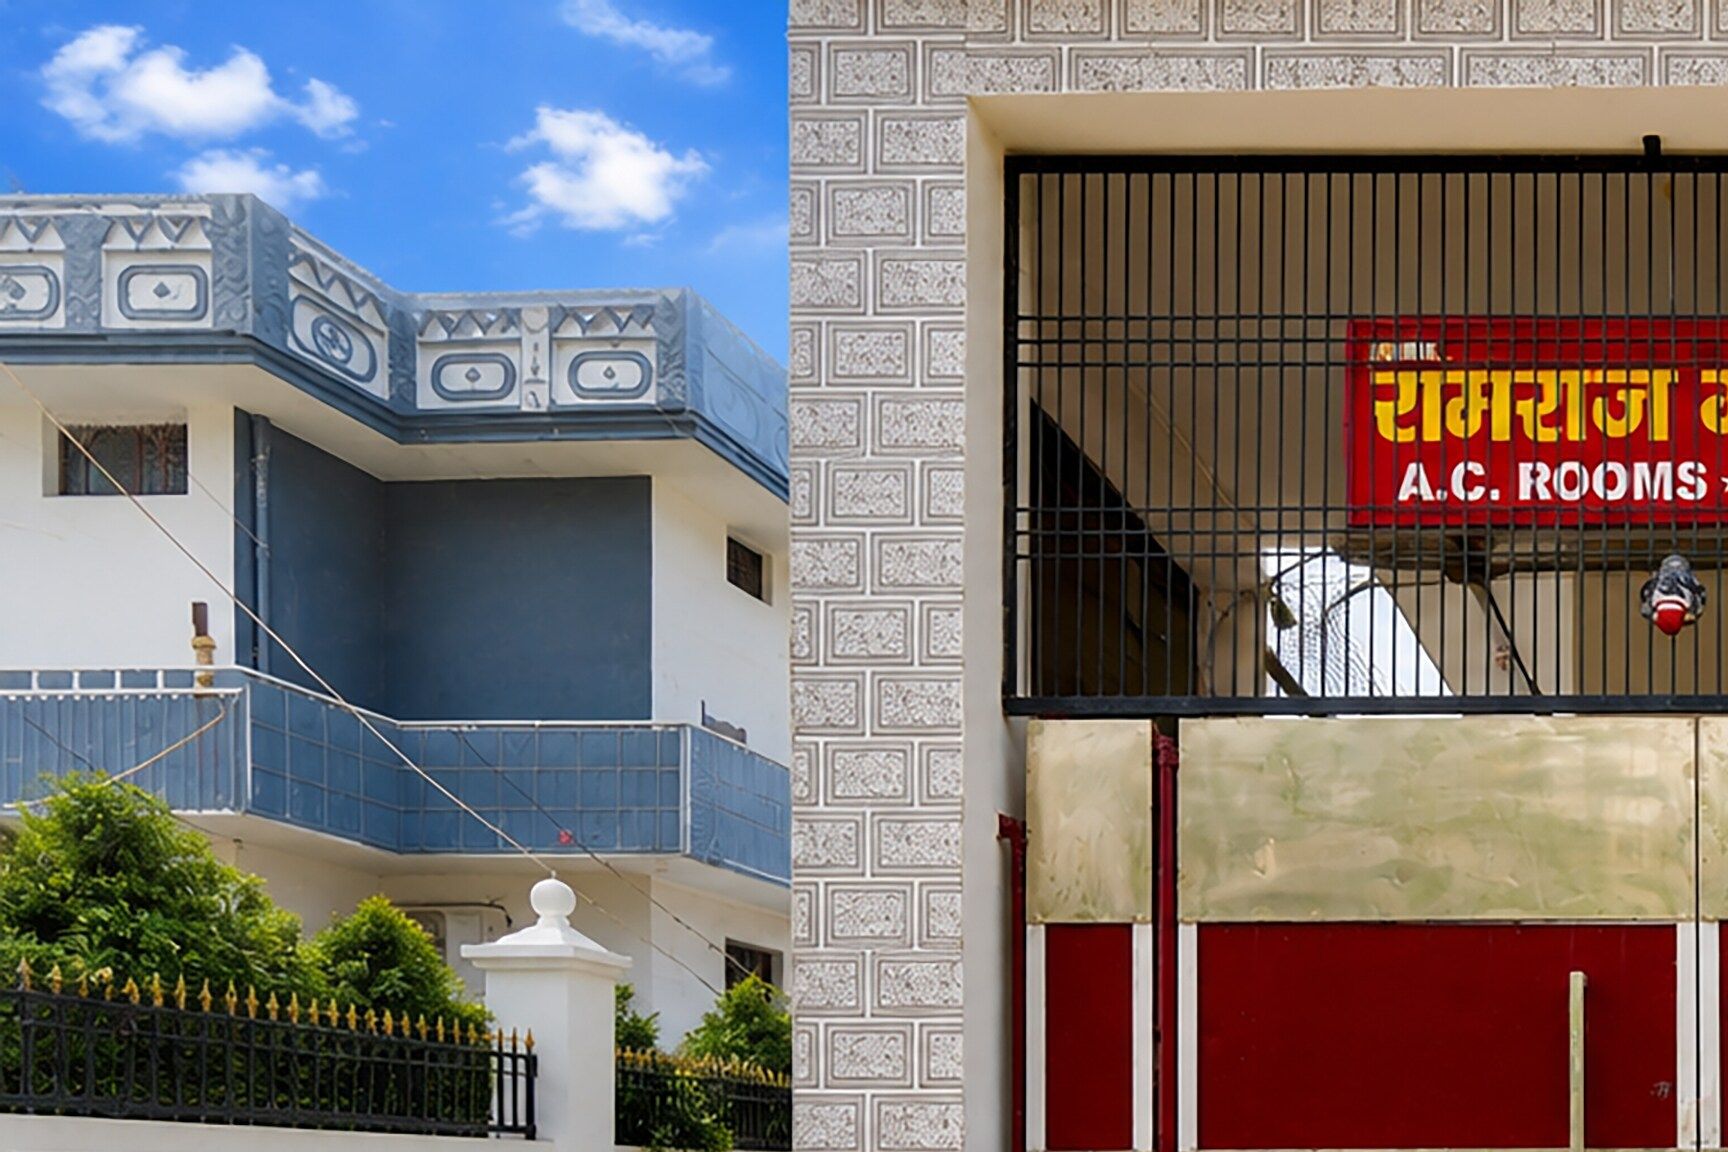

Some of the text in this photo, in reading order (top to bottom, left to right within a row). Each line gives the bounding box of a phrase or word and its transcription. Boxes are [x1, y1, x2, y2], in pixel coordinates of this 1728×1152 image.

[1373, 368, 1679, 443] रामराज
[1397, 460, 1501, 502] A.C.
[1518, 460, 1708, 502] ROOMS
